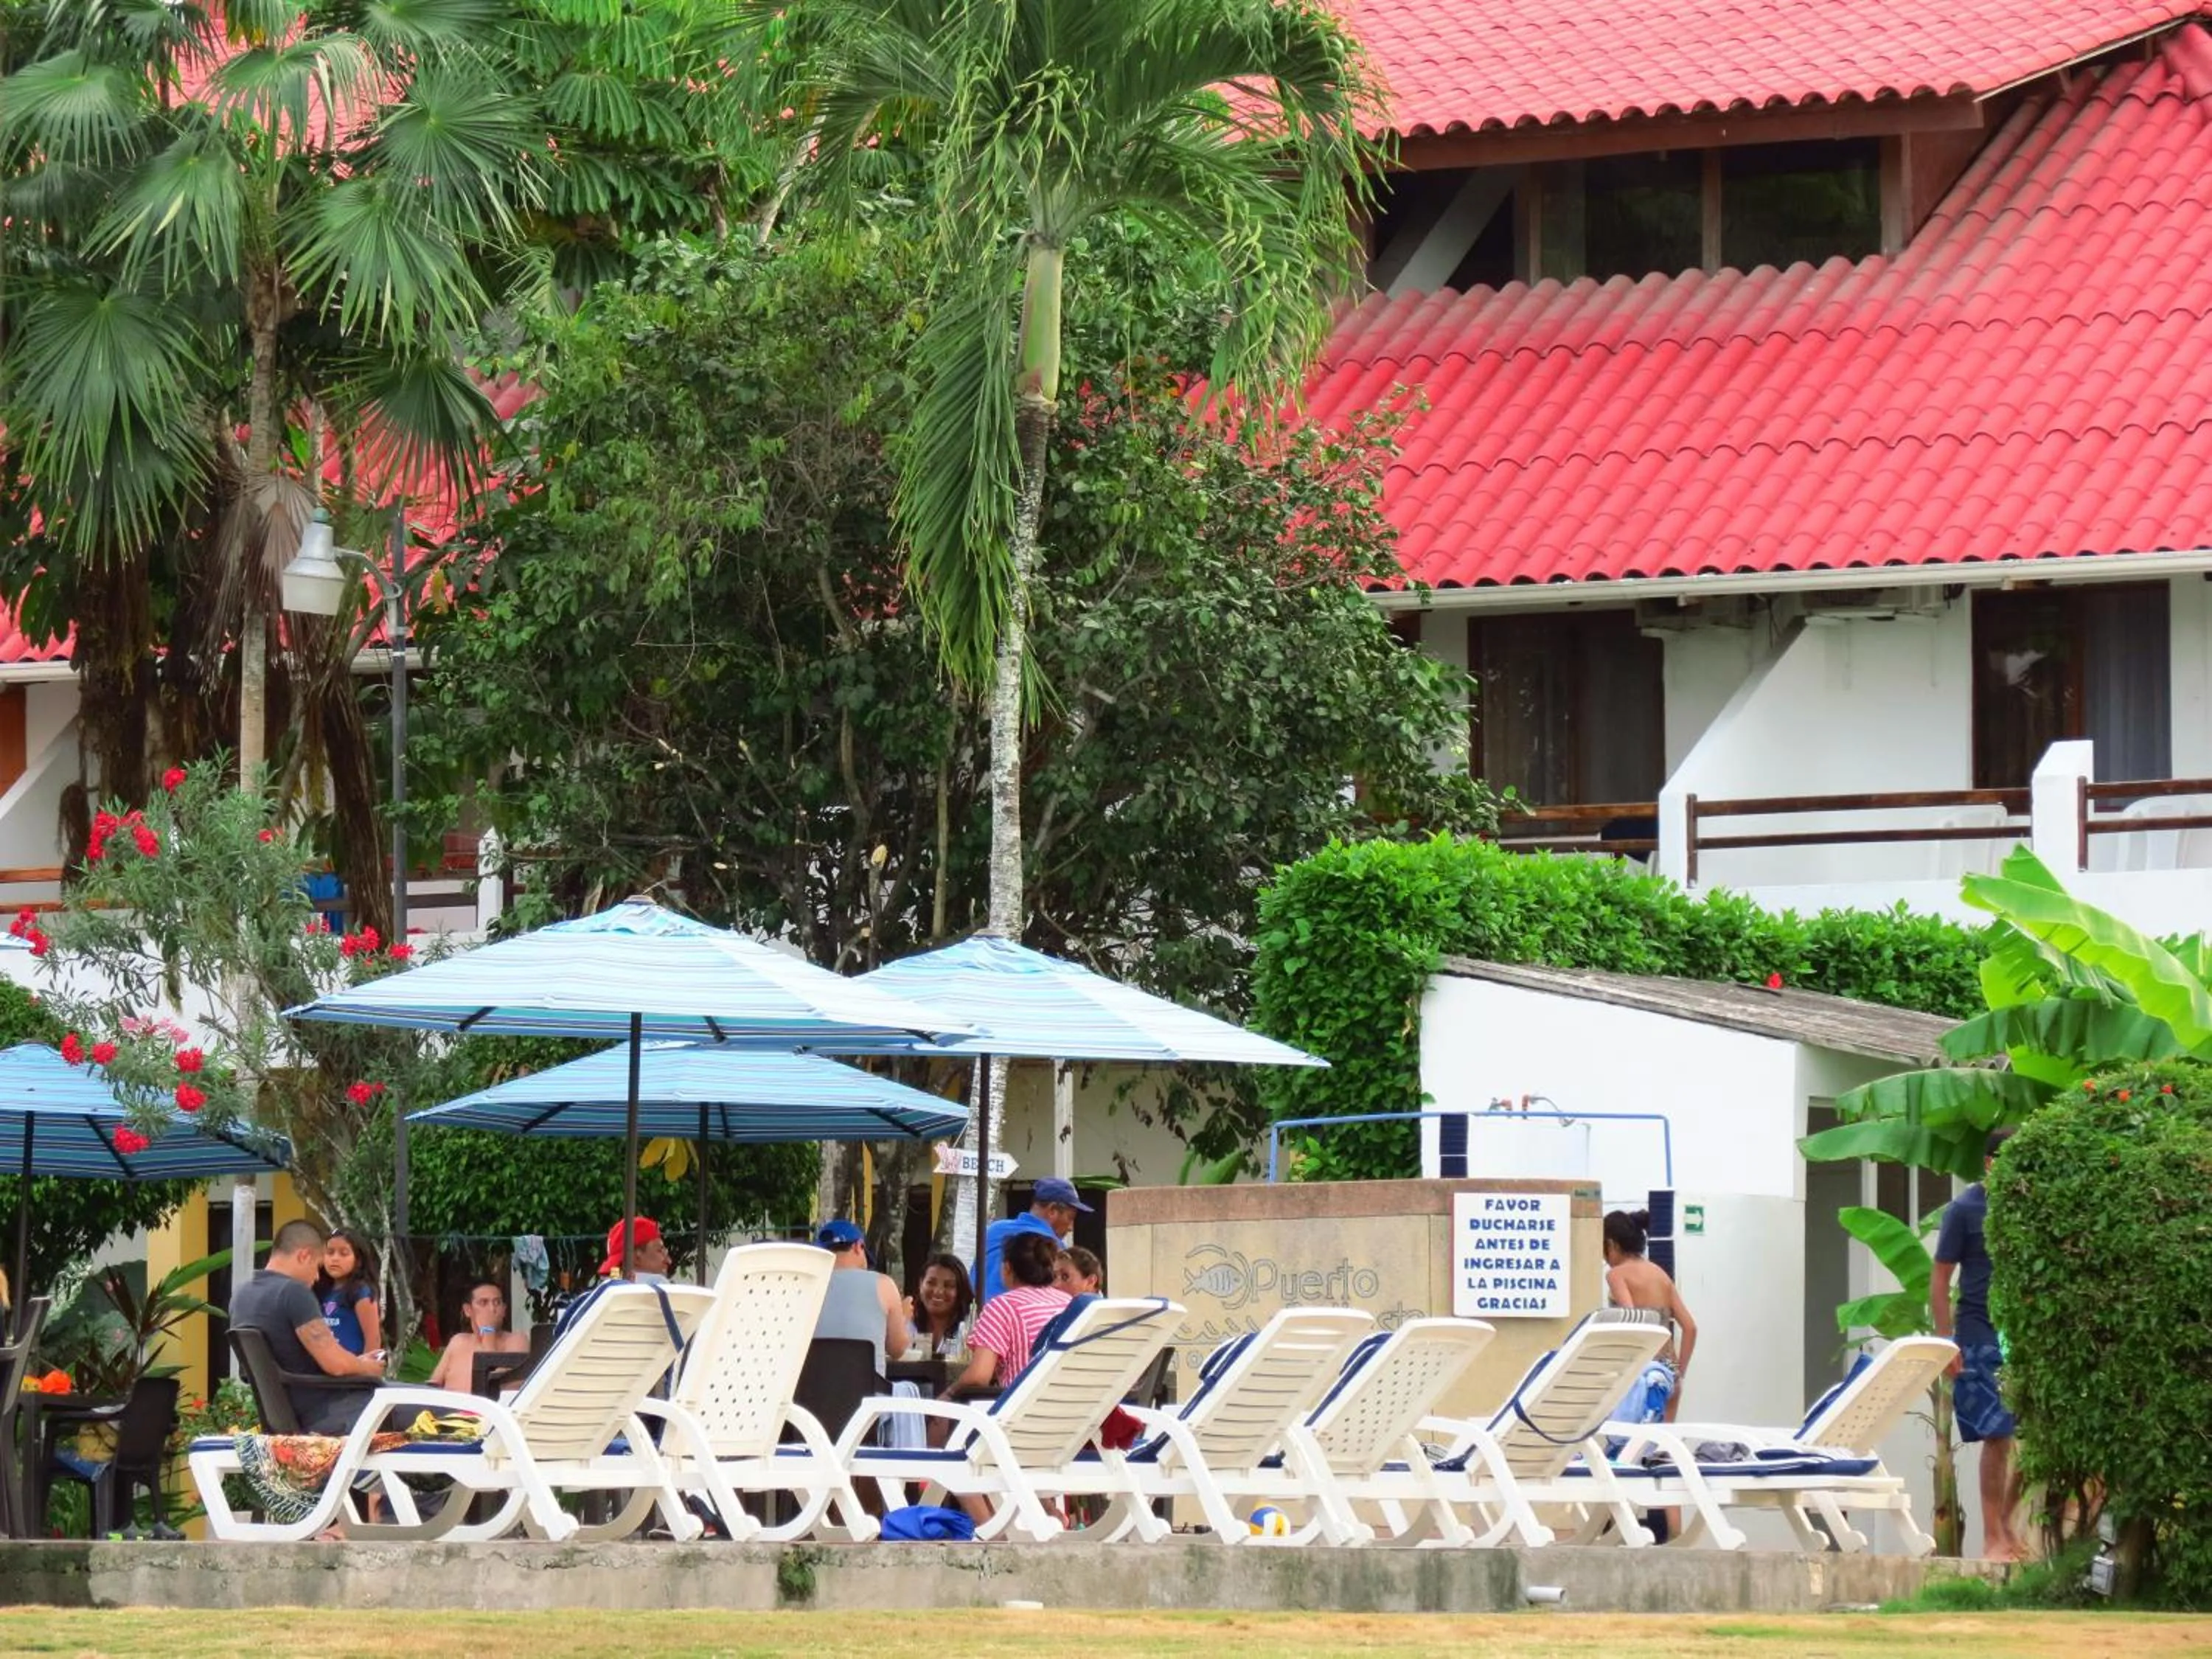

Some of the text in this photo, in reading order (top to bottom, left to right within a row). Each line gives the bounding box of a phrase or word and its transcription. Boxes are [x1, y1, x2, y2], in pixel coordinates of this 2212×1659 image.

[962, 1156, 1004, 1172] BECH
[1485, 1199, 1540, 1211] FAVOR
[1470, 1218, 1555, 1231] DUCHARSE
[1475, 1238, 1550, 1250] ANTES DE
[1464, 1258, 1560, 1270] INGRESAR A
[1251, 1257, 1380, 1303] Puerto
[1467, 1277, 1557, 1290] LA PISCINA
[1477, 1297, 1546, 1310] GRACIAS
